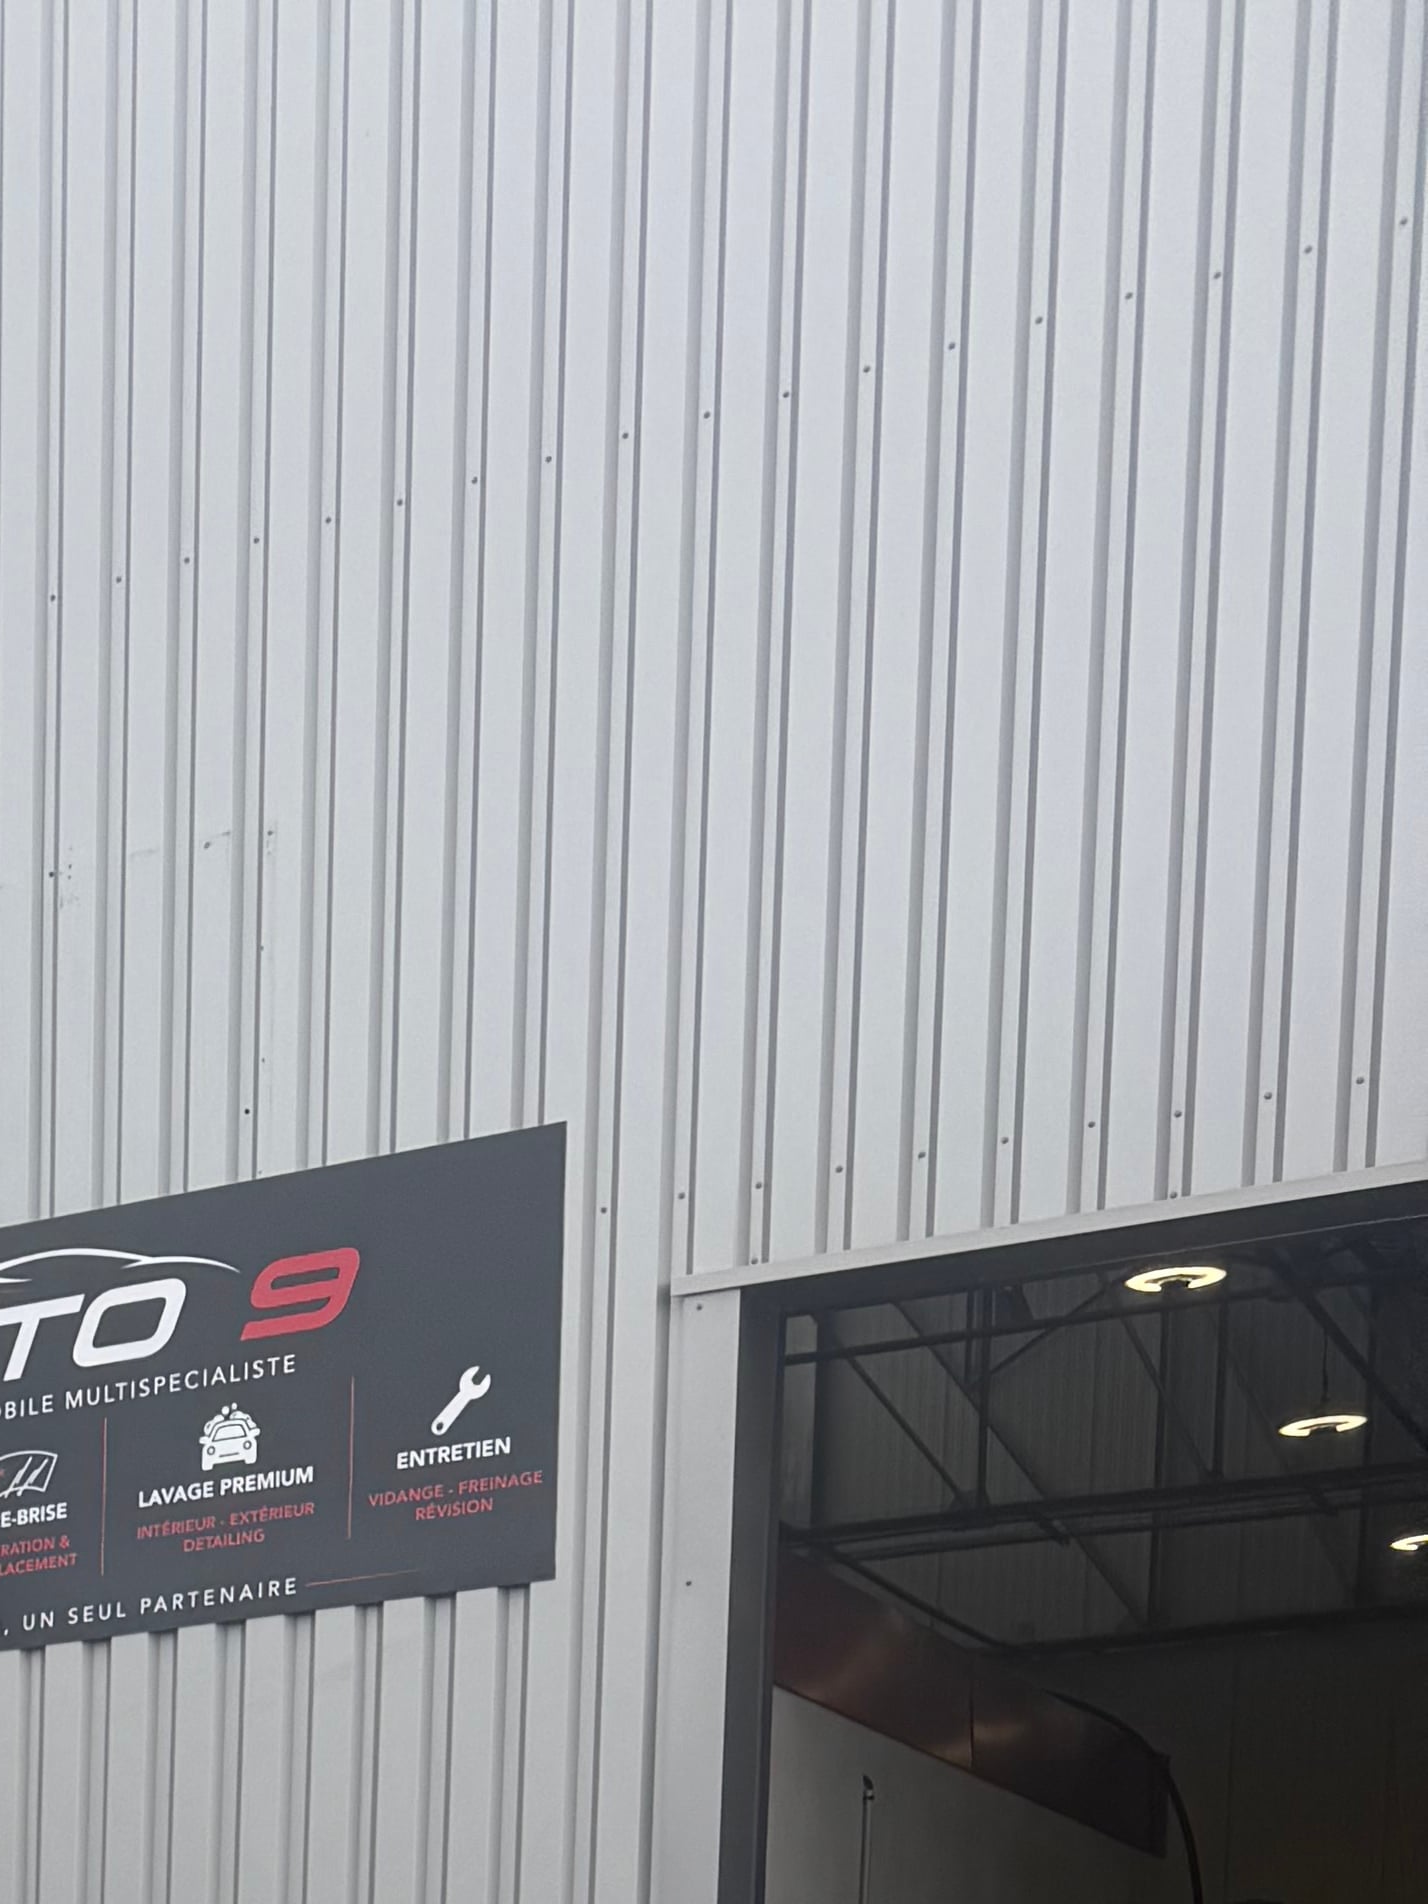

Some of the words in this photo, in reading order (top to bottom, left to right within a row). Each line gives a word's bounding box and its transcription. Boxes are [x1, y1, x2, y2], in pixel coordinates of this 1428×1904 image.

[240, 1247, 360, 1341] 9
[65, 1354, 296, 1409] MULTISPECIALISTE
[396, 1437, 511, 1470] ENTRETIEN
[138, 1481, 214, 1508] LAVAGE
[219, 1466, 314, 1495] PREMIUM
[368, 1484, 443, 1507] VIDANGE
[458, 1470, 544, 1495] FREINAGE
[136, 1513, 216, 1540] INTÉRIEUR
[229, 1502, 315, 1527] EXTÉRIEUR
[415, 1497, 494, 1521] RÉVISION
[58, 1534, 70, 1549] &
[183, 1530, 265, 1553] DETAILING
[23, 1610, 54, 1632] UN
[67, 1599, 126, 1625] SEUL
[140, 1577, 298, 1614] PARTENAIRE
